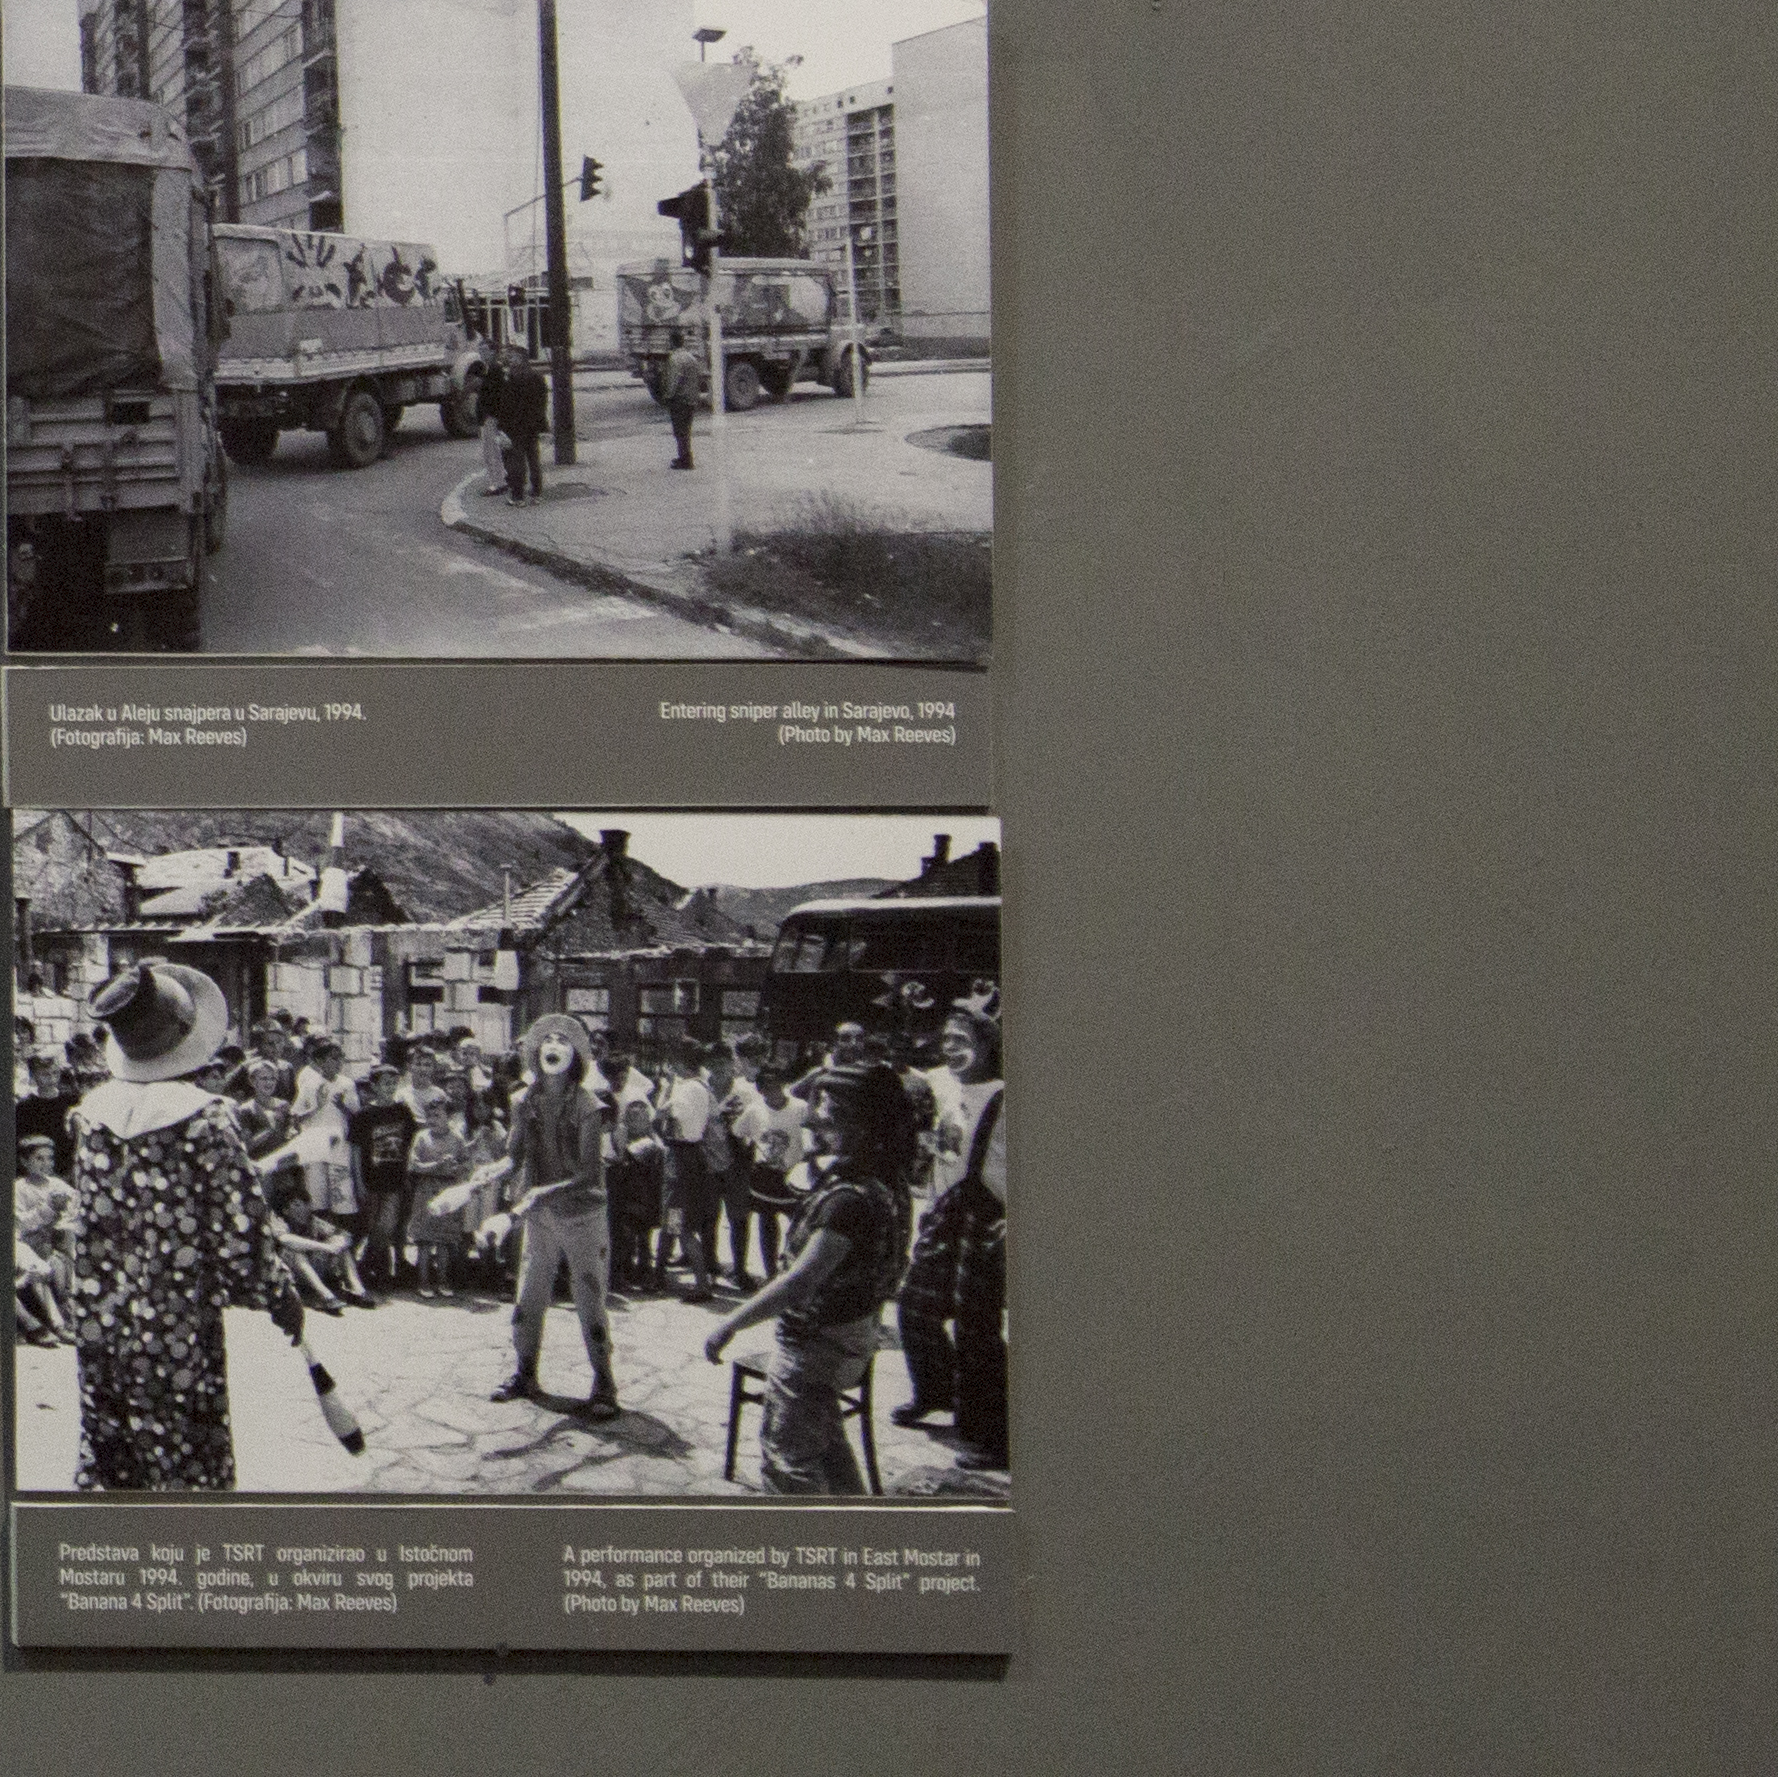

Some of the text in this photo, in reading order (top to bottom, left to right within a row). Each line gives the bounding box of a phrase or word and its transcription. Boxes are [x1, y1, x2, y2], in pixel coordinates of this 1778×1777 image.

[658, 700, 956, 724] Entering sniper alley in Sarajevo, 1994
[562, 1544, 981, 1569] A performance organized by TSRT in East Mostar in
